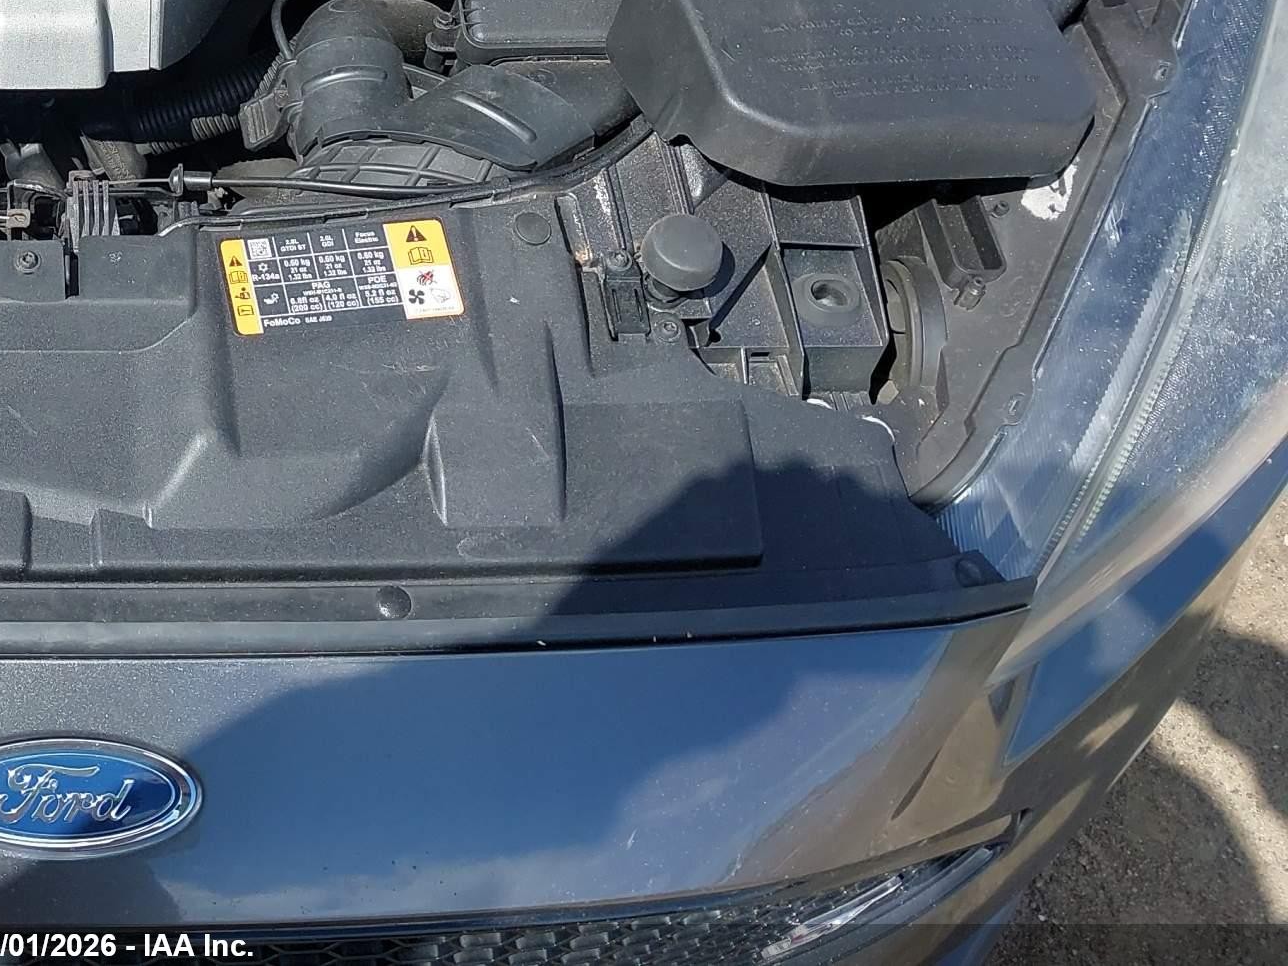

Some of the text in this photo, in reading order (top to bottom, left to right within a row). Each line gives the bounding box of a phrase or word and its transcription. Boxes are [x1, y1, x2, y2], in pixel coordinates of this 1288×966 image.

[335, 254, 346, 263] kg
[374, 251, 385, 259] kg
[300, 258, 311, 267] kg
[252, 273, 280, 282] R-134a
[367, 275, 388, 284] POE
[312, 281, 331, 290] PAG
[310, 302, 324, 311] cc)
[346, 299, 360, 308] cc)
[264, 317, 301, 327] FoMoCo
